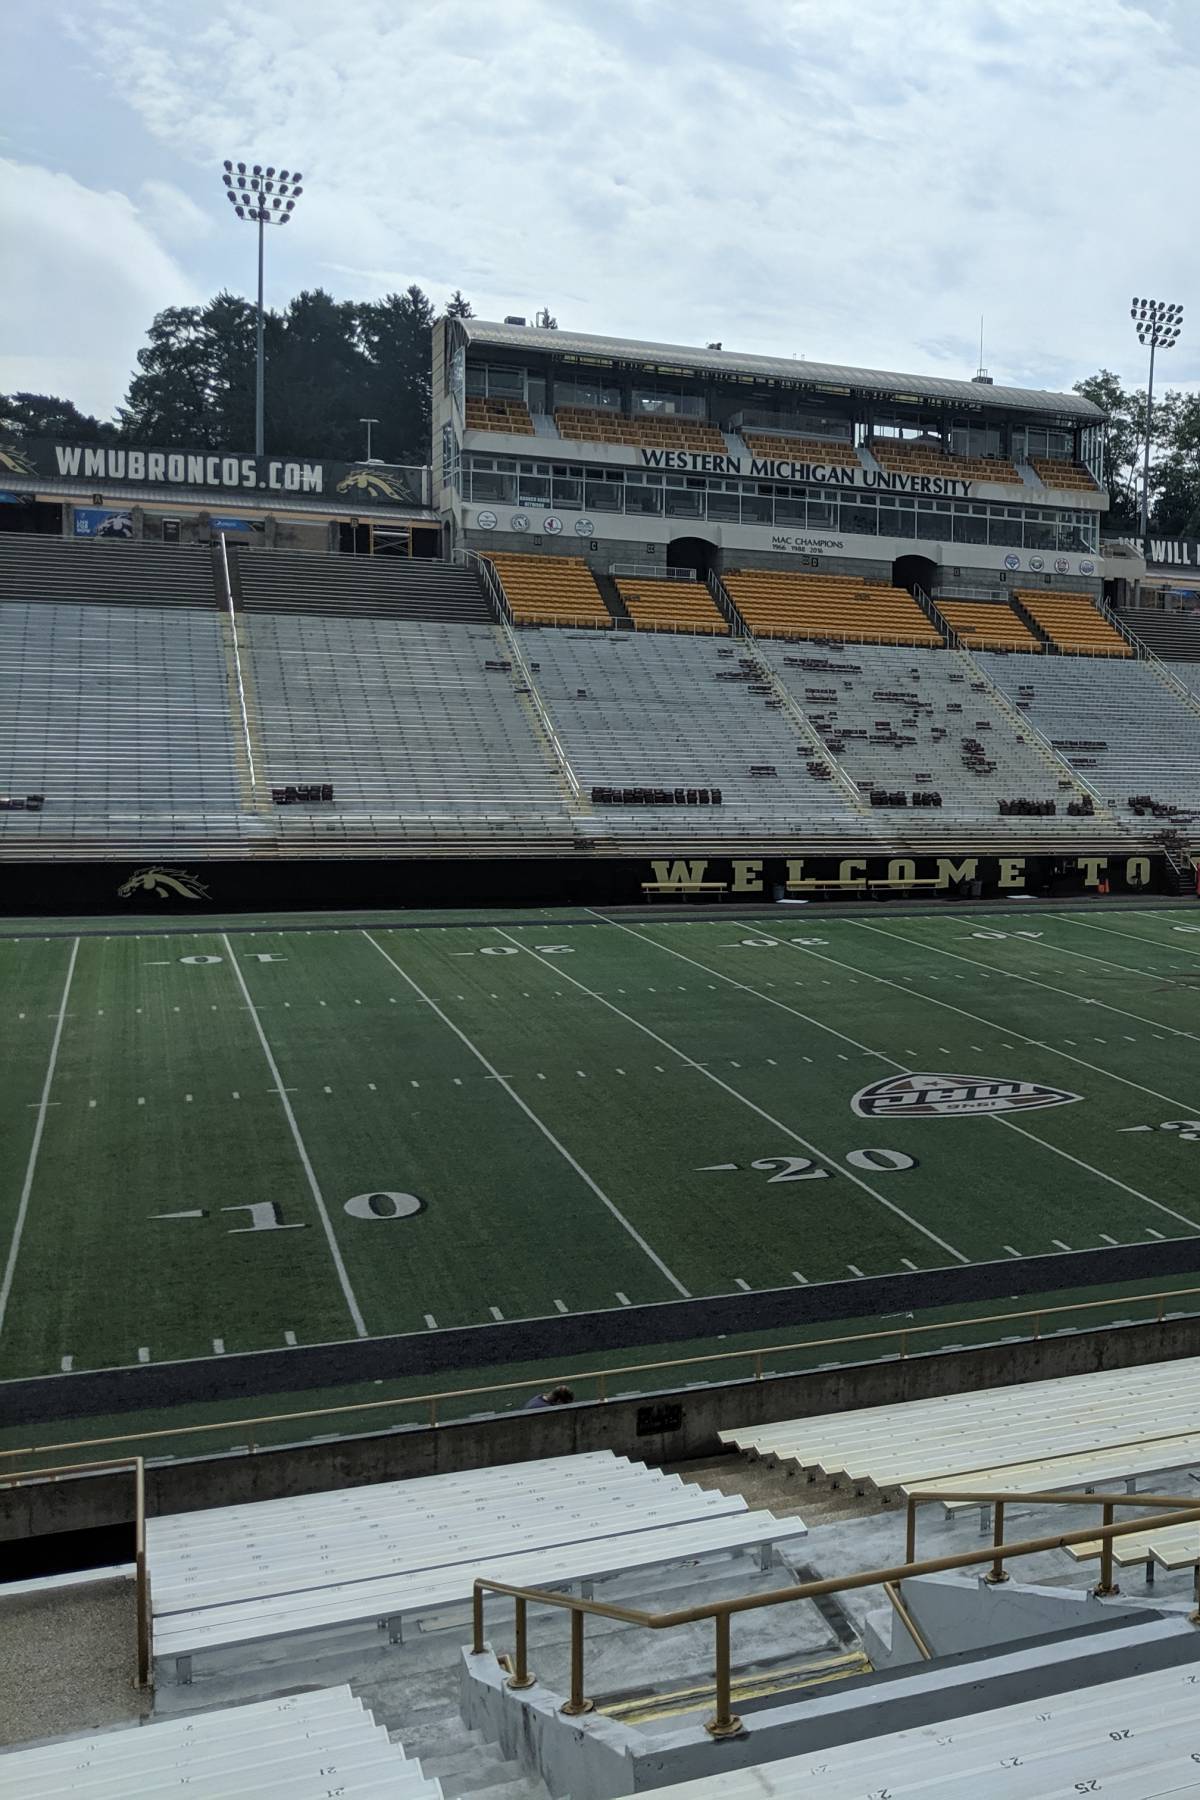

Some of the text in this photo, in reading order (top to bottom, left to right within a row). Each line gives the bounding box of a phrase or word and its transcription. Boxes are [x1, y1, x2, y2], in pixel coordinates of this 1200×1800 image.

[55, 446, 323, 493] WMUBRONCOS.COM
[641, 448, 972, 496] WESTERN MICHIGAN UNIVERSITY
[772, 536, 844, 549] MAC CHAMPIONS
[1150, 539, 1191, 565] WILL
[651, 858, 1026, 892] WELCOME
[1077, 856, 1151, 886] TO
[751, 1148, 915, 1183] 20
[220, 1191, 422, 1233] 10
[1074, 1779, 1102, 1794] 25
